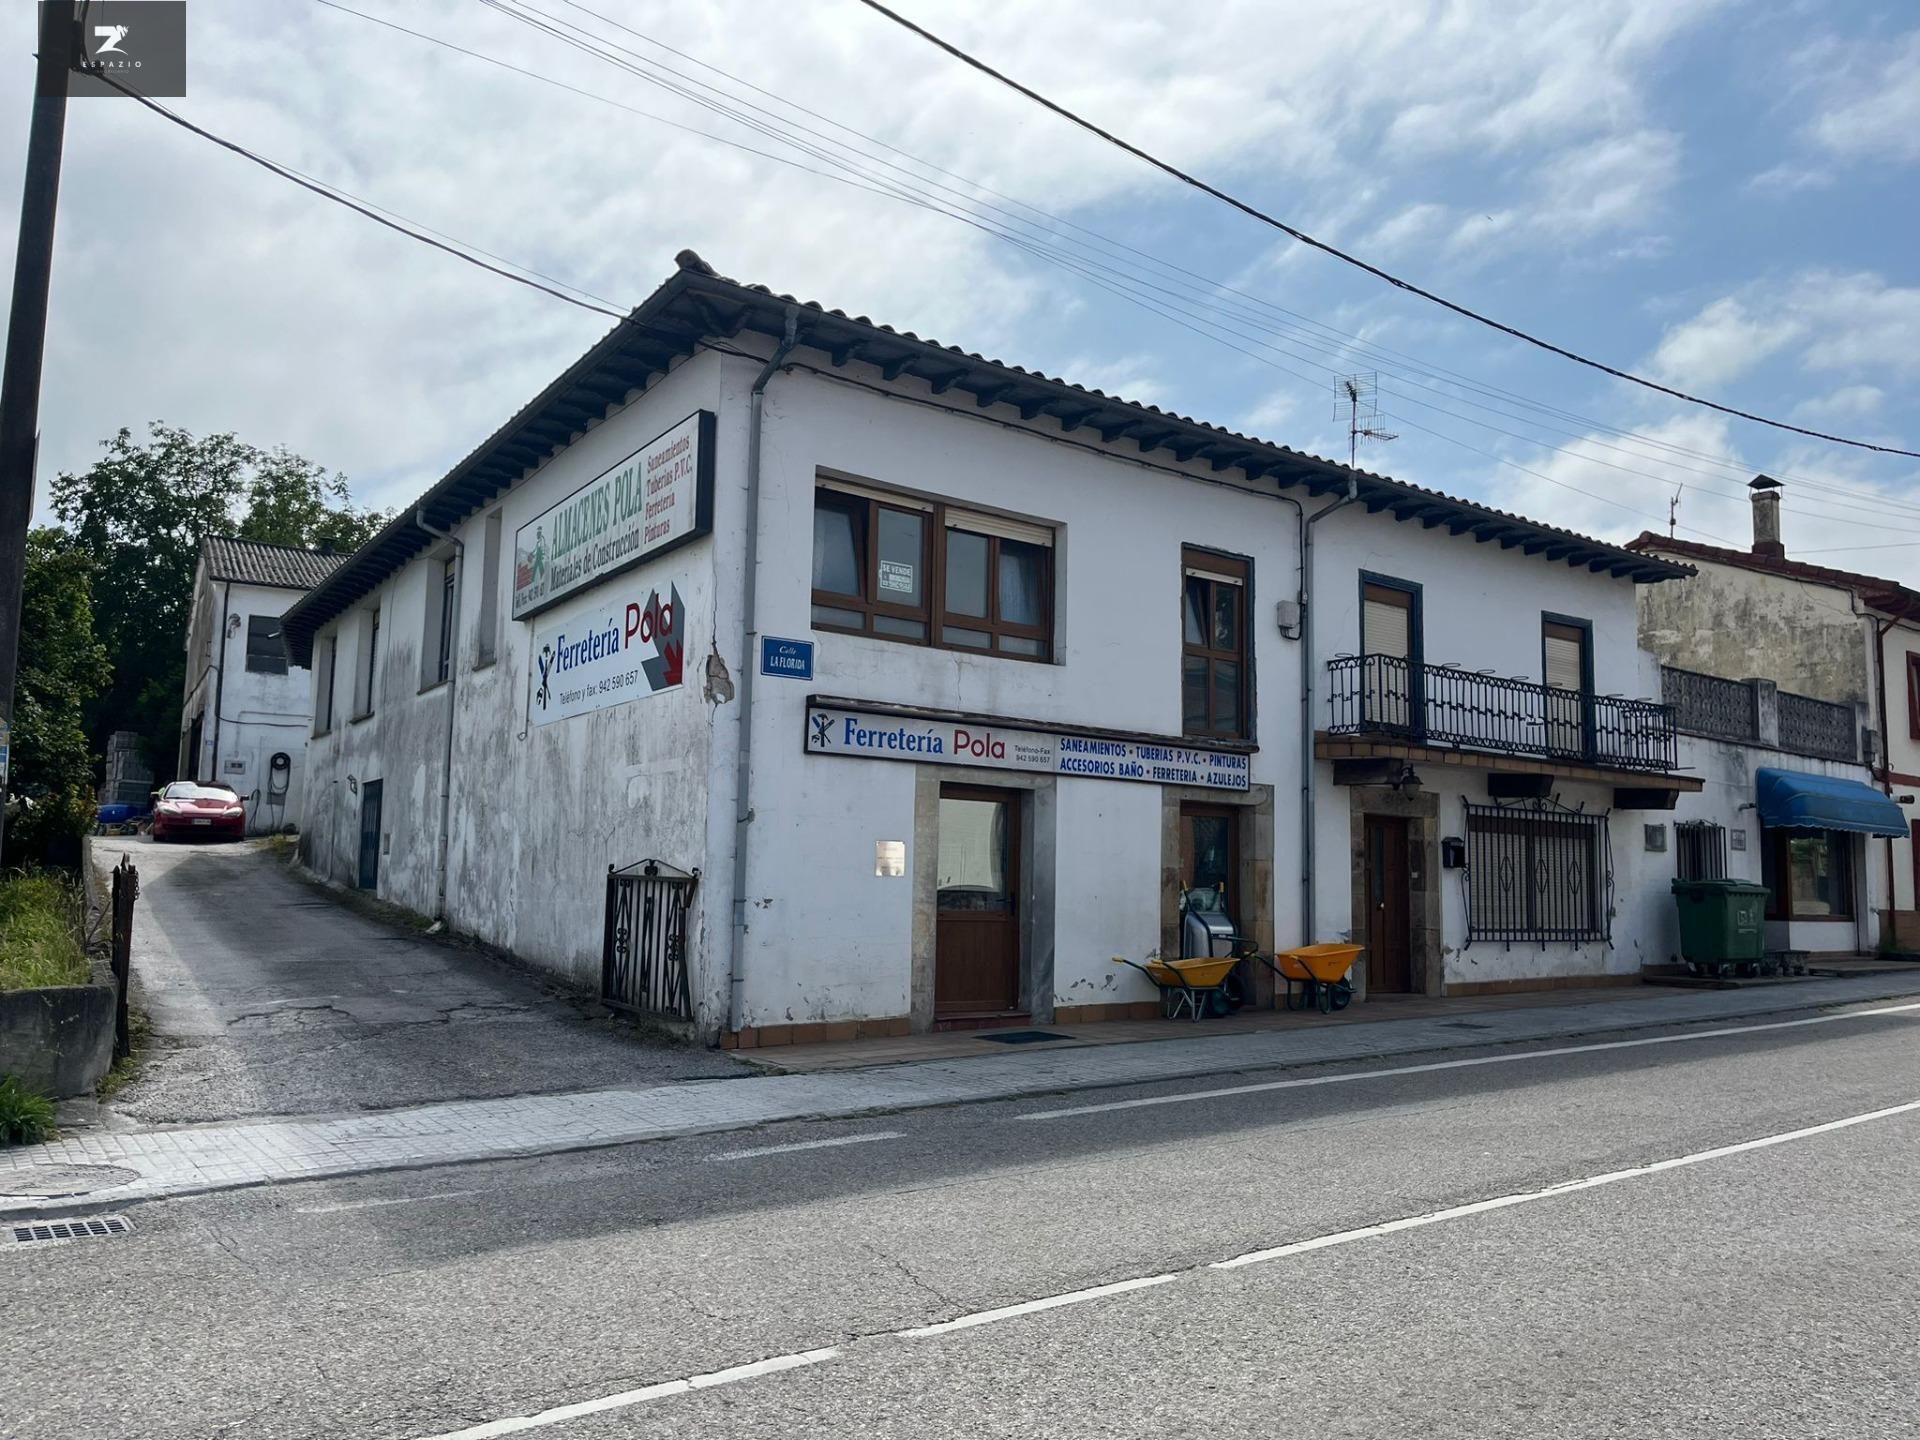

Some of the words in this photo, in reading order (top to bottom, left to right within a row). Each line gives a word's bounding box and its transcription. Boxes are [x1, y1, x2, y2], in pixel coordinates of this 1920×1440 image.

[647, 435, 690, 474] Saneamientos
[674, 454, 693, 482] P.V.C.
[551, 481, 610, 561] ALMACENES
[613, 462, 643, 526] POLA
[644, 519, 670, 544] Pinturas
[550, 556, 582, 592] Materiales
[583, 555, 592, 573] de
[593, 523, 640, 570] Construcción
[891, 566, 912, 576] VENDE
[556, 617, 619, 673] Ferretería
[625, 593, 674, 649] Pola
[770, 656, 779, 667] LA
[779, 656, 806, 670] FLORIDA
[779, 645, 797, 655] Calle
[560, 689, 581, 704] Teléfono
[599, 678, 611, 694] 942
[612, 674, 624, 690] 590
[625, 670, 638, 686] 657
[843, 717, 943, 754] Ferretería
[953, 729, 1006, 759] Pola
[1060, 737, 1127, 758] SANEAMIENTOS
[1136, 746, 1174, 762] TUBERIAS
[1176, 749, 1201, 766] P.V.C.
[1209, 754, 1247, 770] PINTURAS
[1016, 754, 1027, 762] 942
[1028, 755, 1039, 763] 590
[1060, 757, 1115, 775] ACCESORIOS
[1119, 760, 1144, 778] BAÑO
[1152, 766, 1198, 782] FERRETERIA
[1206, 773, 1247, 788] AZULEJOS
